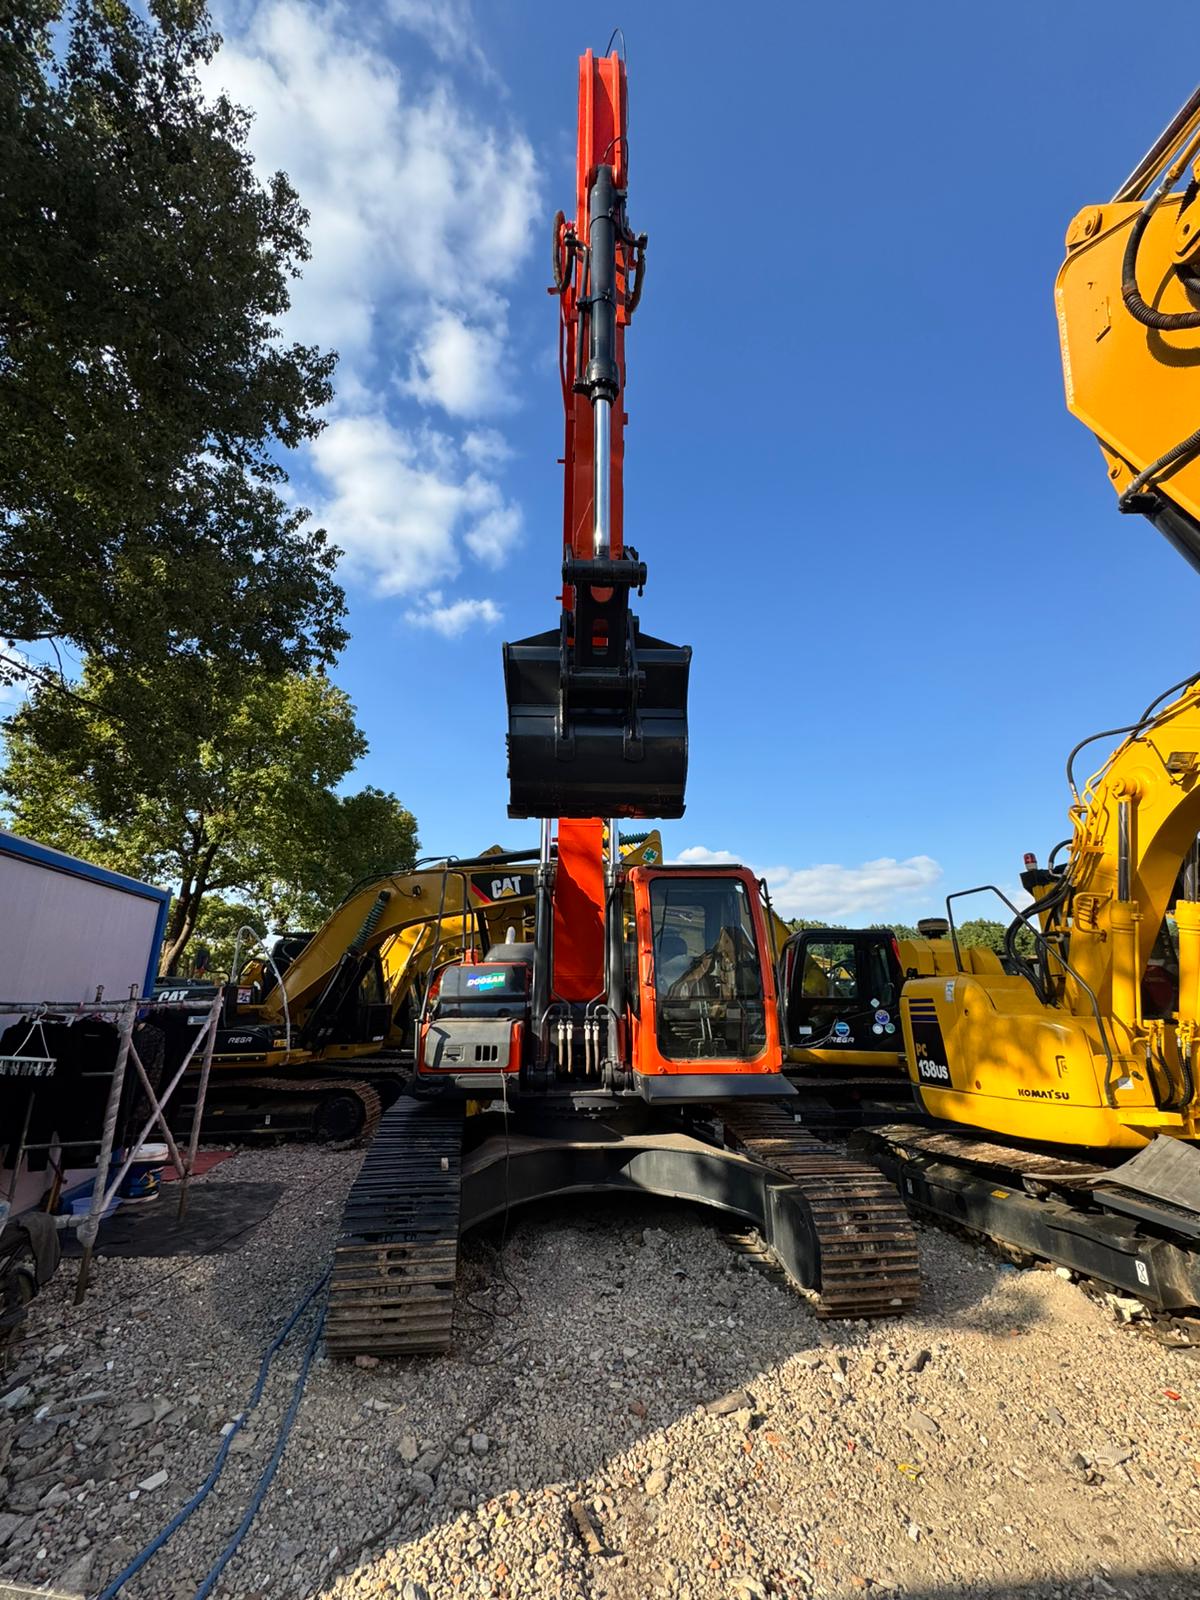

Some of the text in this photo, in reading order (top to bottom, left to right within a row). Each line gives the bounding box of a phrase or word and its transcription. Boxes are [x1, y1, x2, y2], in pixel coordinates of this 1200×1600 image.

[491, 875, 521, 899] CAT
[466, 975, 505, 987] DOOSAN
[158, 990, 189, 1002] CAT
[916, 1043, 928, 1057] PC
[1017, 1088, 1070, 1100] KOMATSU
